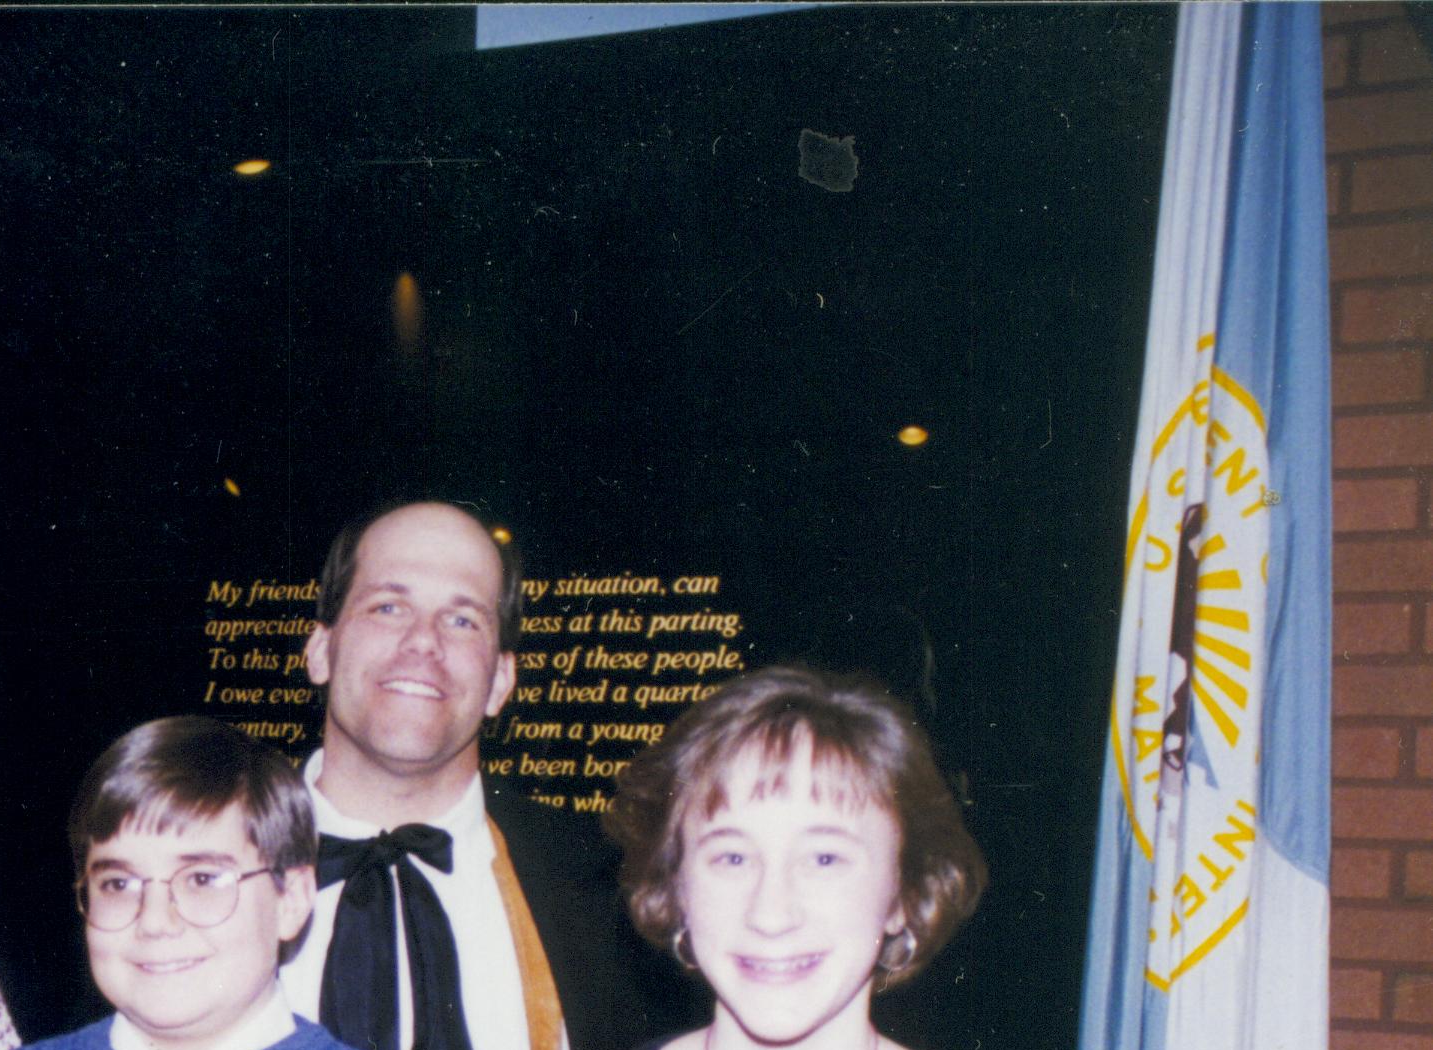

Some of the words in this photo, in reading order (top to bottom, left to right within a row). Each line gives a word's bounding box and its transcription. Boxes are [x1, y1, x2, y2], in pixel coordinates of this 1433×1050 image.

[206, 580, 242, 608] My
[554, 571, 666, 596] situation,
[673, 575, 719, 594] can
[205, 617, 316, 642] appreciate
[569, 614, 593, 632] at
[599, 609, 643, 632] this
[647, 608, 744, 638] parting.
[210, 648, 236, 669] To
[242, 648, 280, 669] this
[552, 646, 582, 675] of
[585, 645, 649, 669] these
[652, 644, 745, 675] people,
[204, 681, 216, 702] I
[220, 688, 264, 704] owe
[516, 687, 543, 703] ve
[549, 679, 608, 703] lived
[612, 685, 628, 702] a
[634, 683, 722, 709] quarte
[231, 721, 307, 744] entury,
[568, 722, 584, 739] a
[587, 723, 665, 747] young
[488, 758, 514, 775] ve
[519, 753, 576, 776] been
[584, 754, 632, 777] bor
